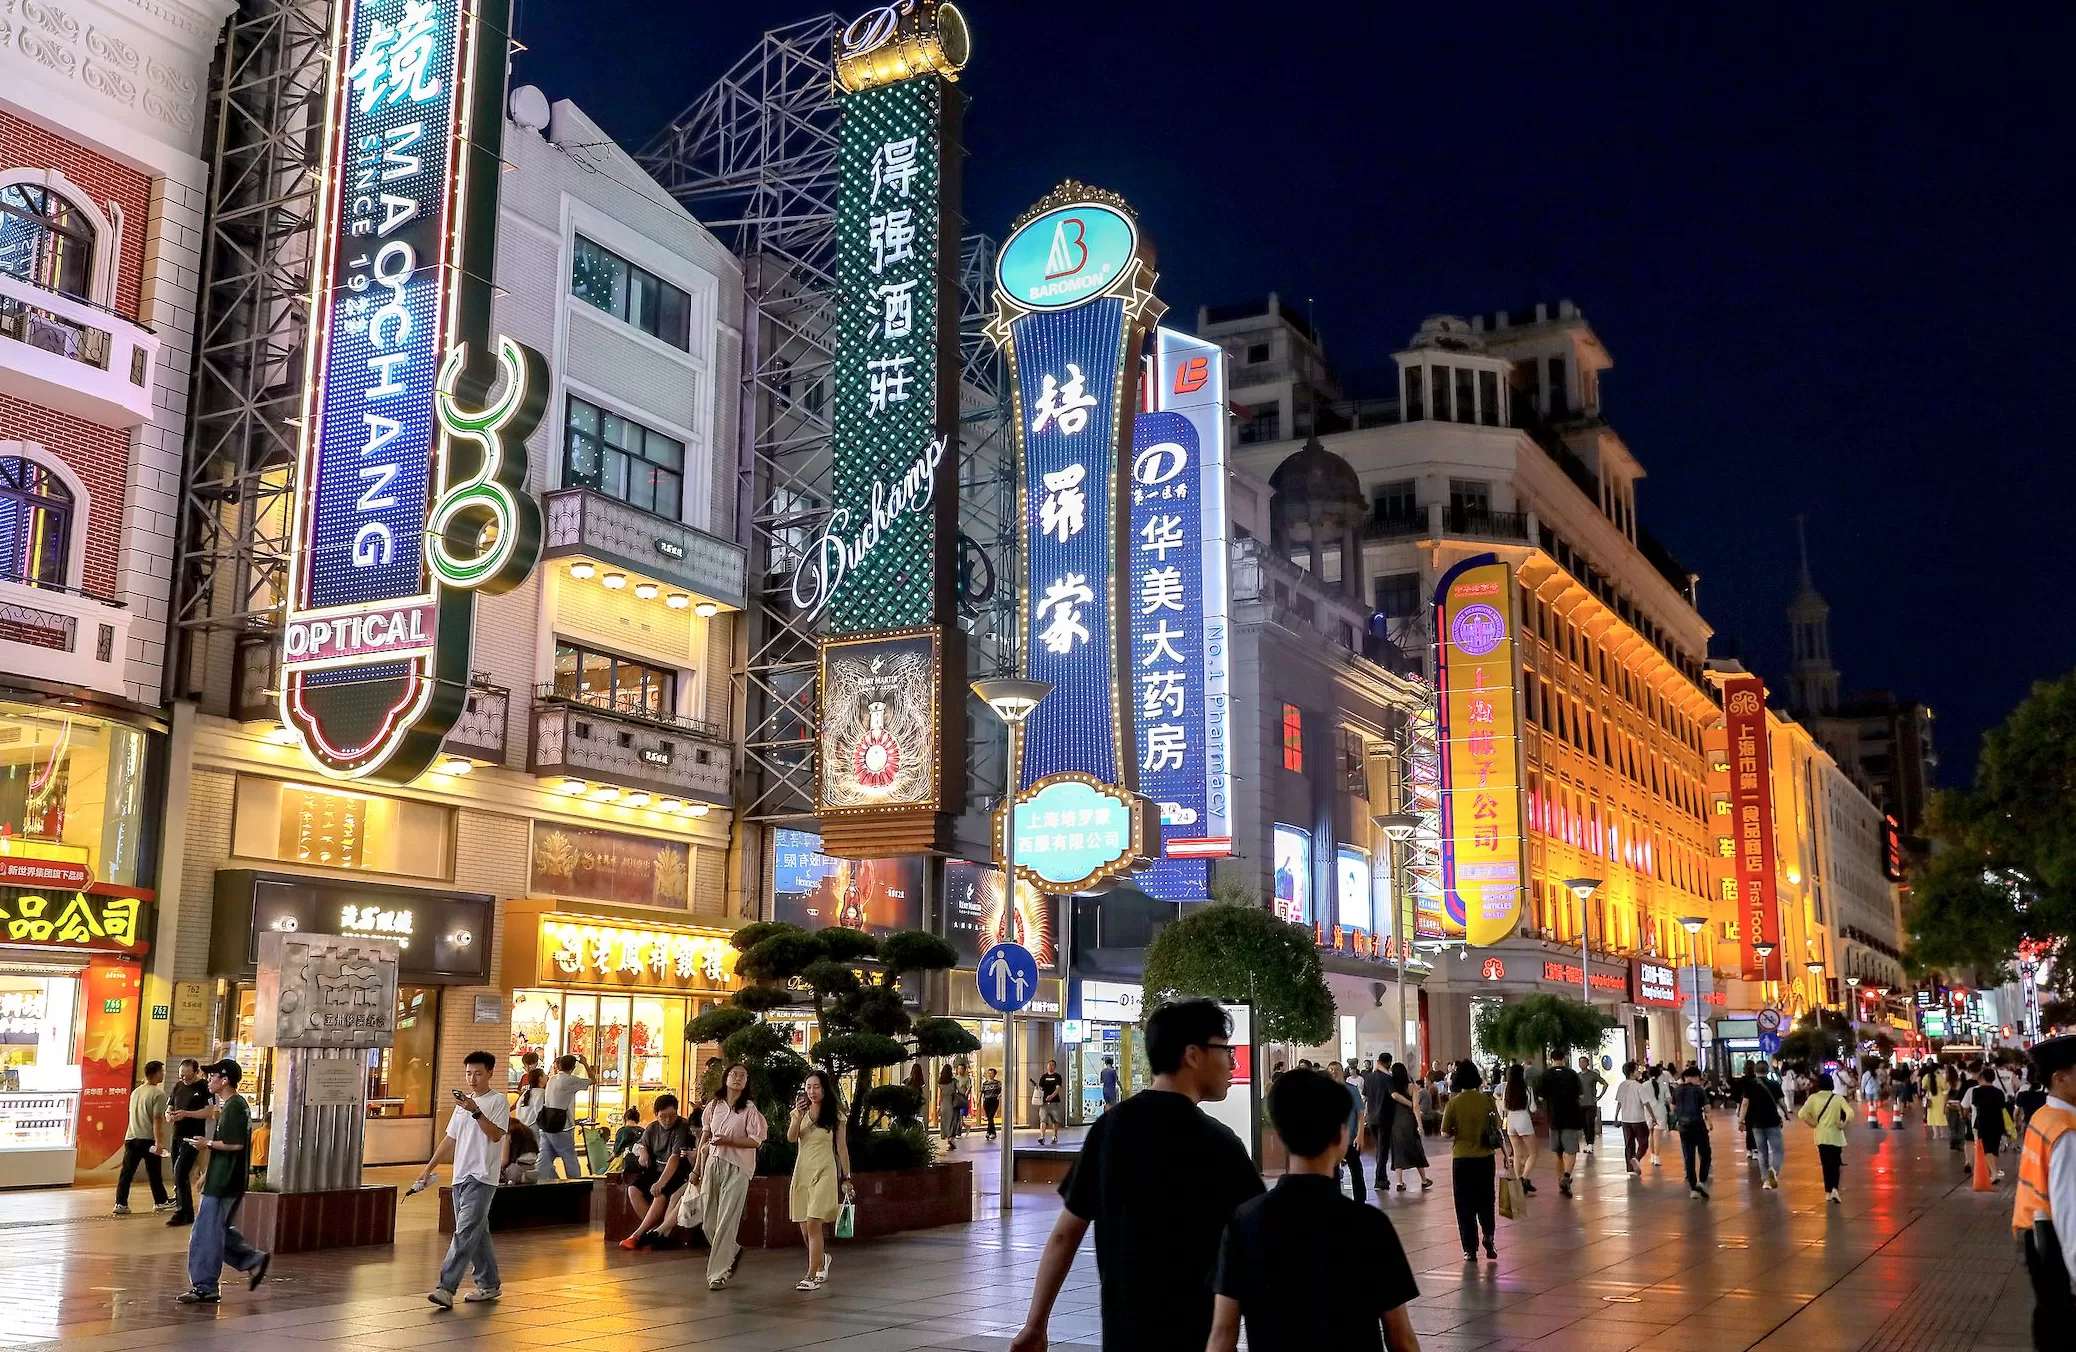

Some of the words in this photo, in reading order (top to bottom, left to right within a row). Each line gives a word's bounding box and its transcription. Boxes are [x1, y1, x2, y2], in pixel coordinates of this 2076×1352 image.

[351, 134, 380, 238] SINCE
[343, 253, 372, 335] 1923
[353, 121, 426, 567] MAOCHANG
[792, 434, 948, 623] Duchamp
[284, 609, 428, 657] OPTICAL
[1140, 514, 1187, 772] 华美大药房
[1207, 624, 1224, 681] No.1
[1208, 695, 1226, 818] Pharmacy
[1738, 723, 1763, 872] 上海市第一食品商店
[1018, 831, 1119, 853] 西服有限公司
[8, 864, 84, 880] 新世界集团旗下品牌
[1748, 881, 1763, 906] First
[0, 892, 141, 946] 品公司
[106, 1000, 120, 1009] 766
[154, 1006, 167, 1015] 762
[187, 985, 200, 994] 762
